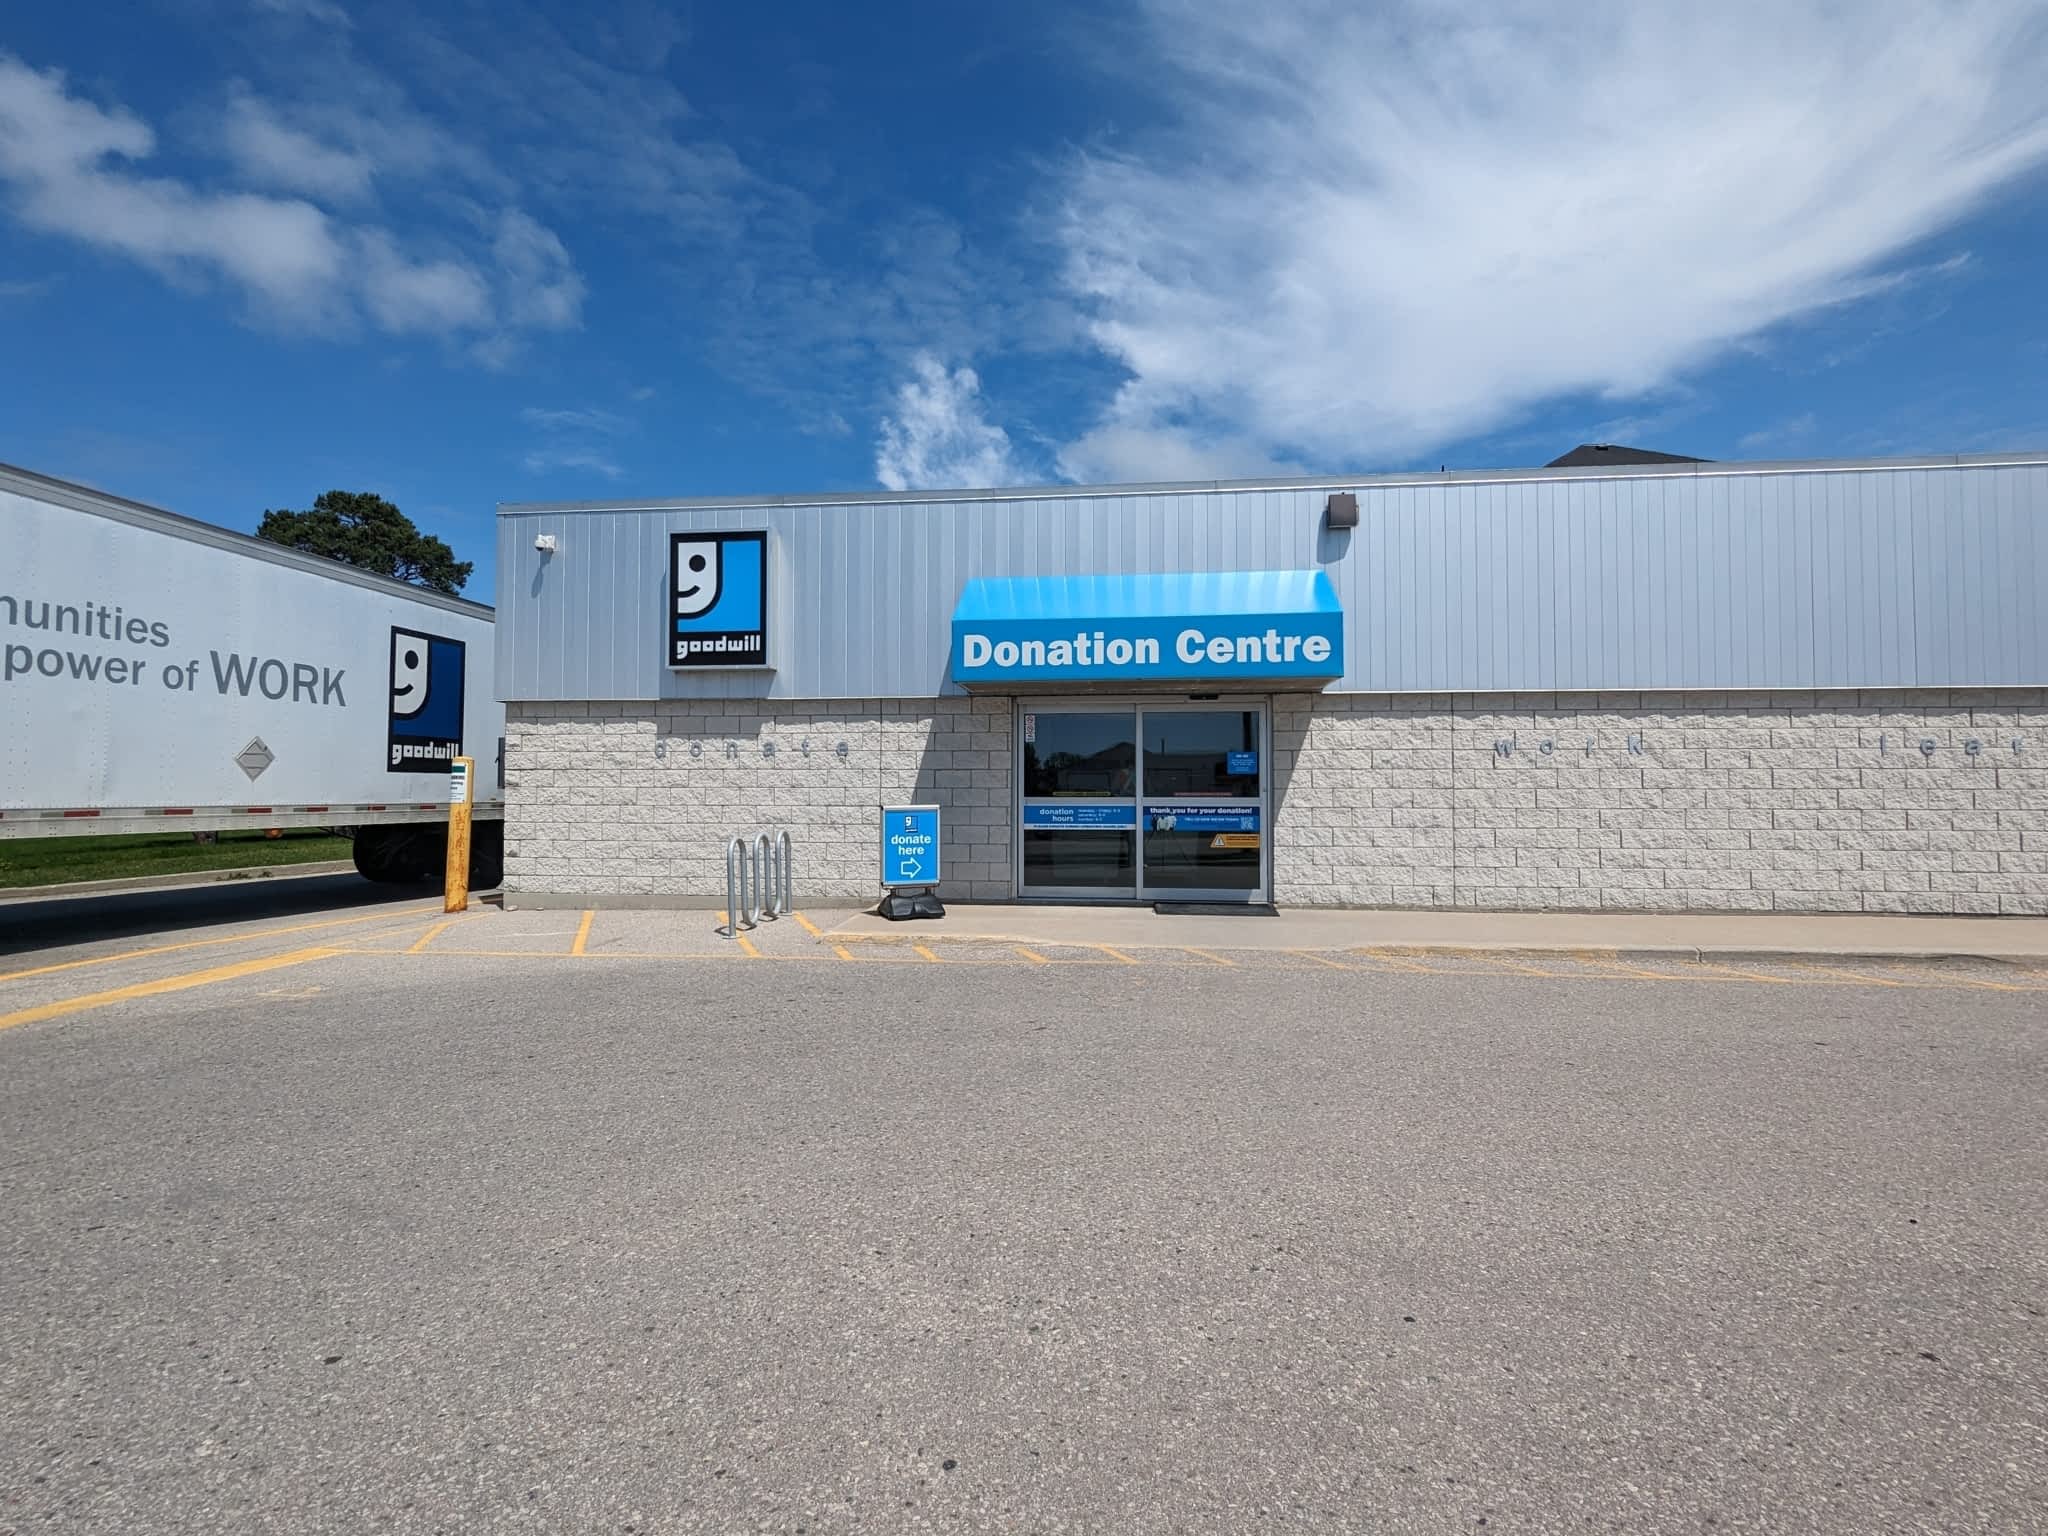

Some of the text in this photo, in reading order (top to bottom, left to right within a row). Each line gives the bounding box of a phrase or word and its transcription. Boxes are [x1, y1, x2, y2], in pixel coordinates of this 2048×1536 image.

[676, 634, 761, 660] goodwill
[963, 629, 1332, 668] Donation Centre
[4, 644, 346, 707] power of WORK
[391, 741, 459, 765] goodwill
[655, 736, 849, 759] donate
[1494, 735, 1642, 759] work
[890, 834, 932, 845] donate
[898, 845, 925, 855] here
